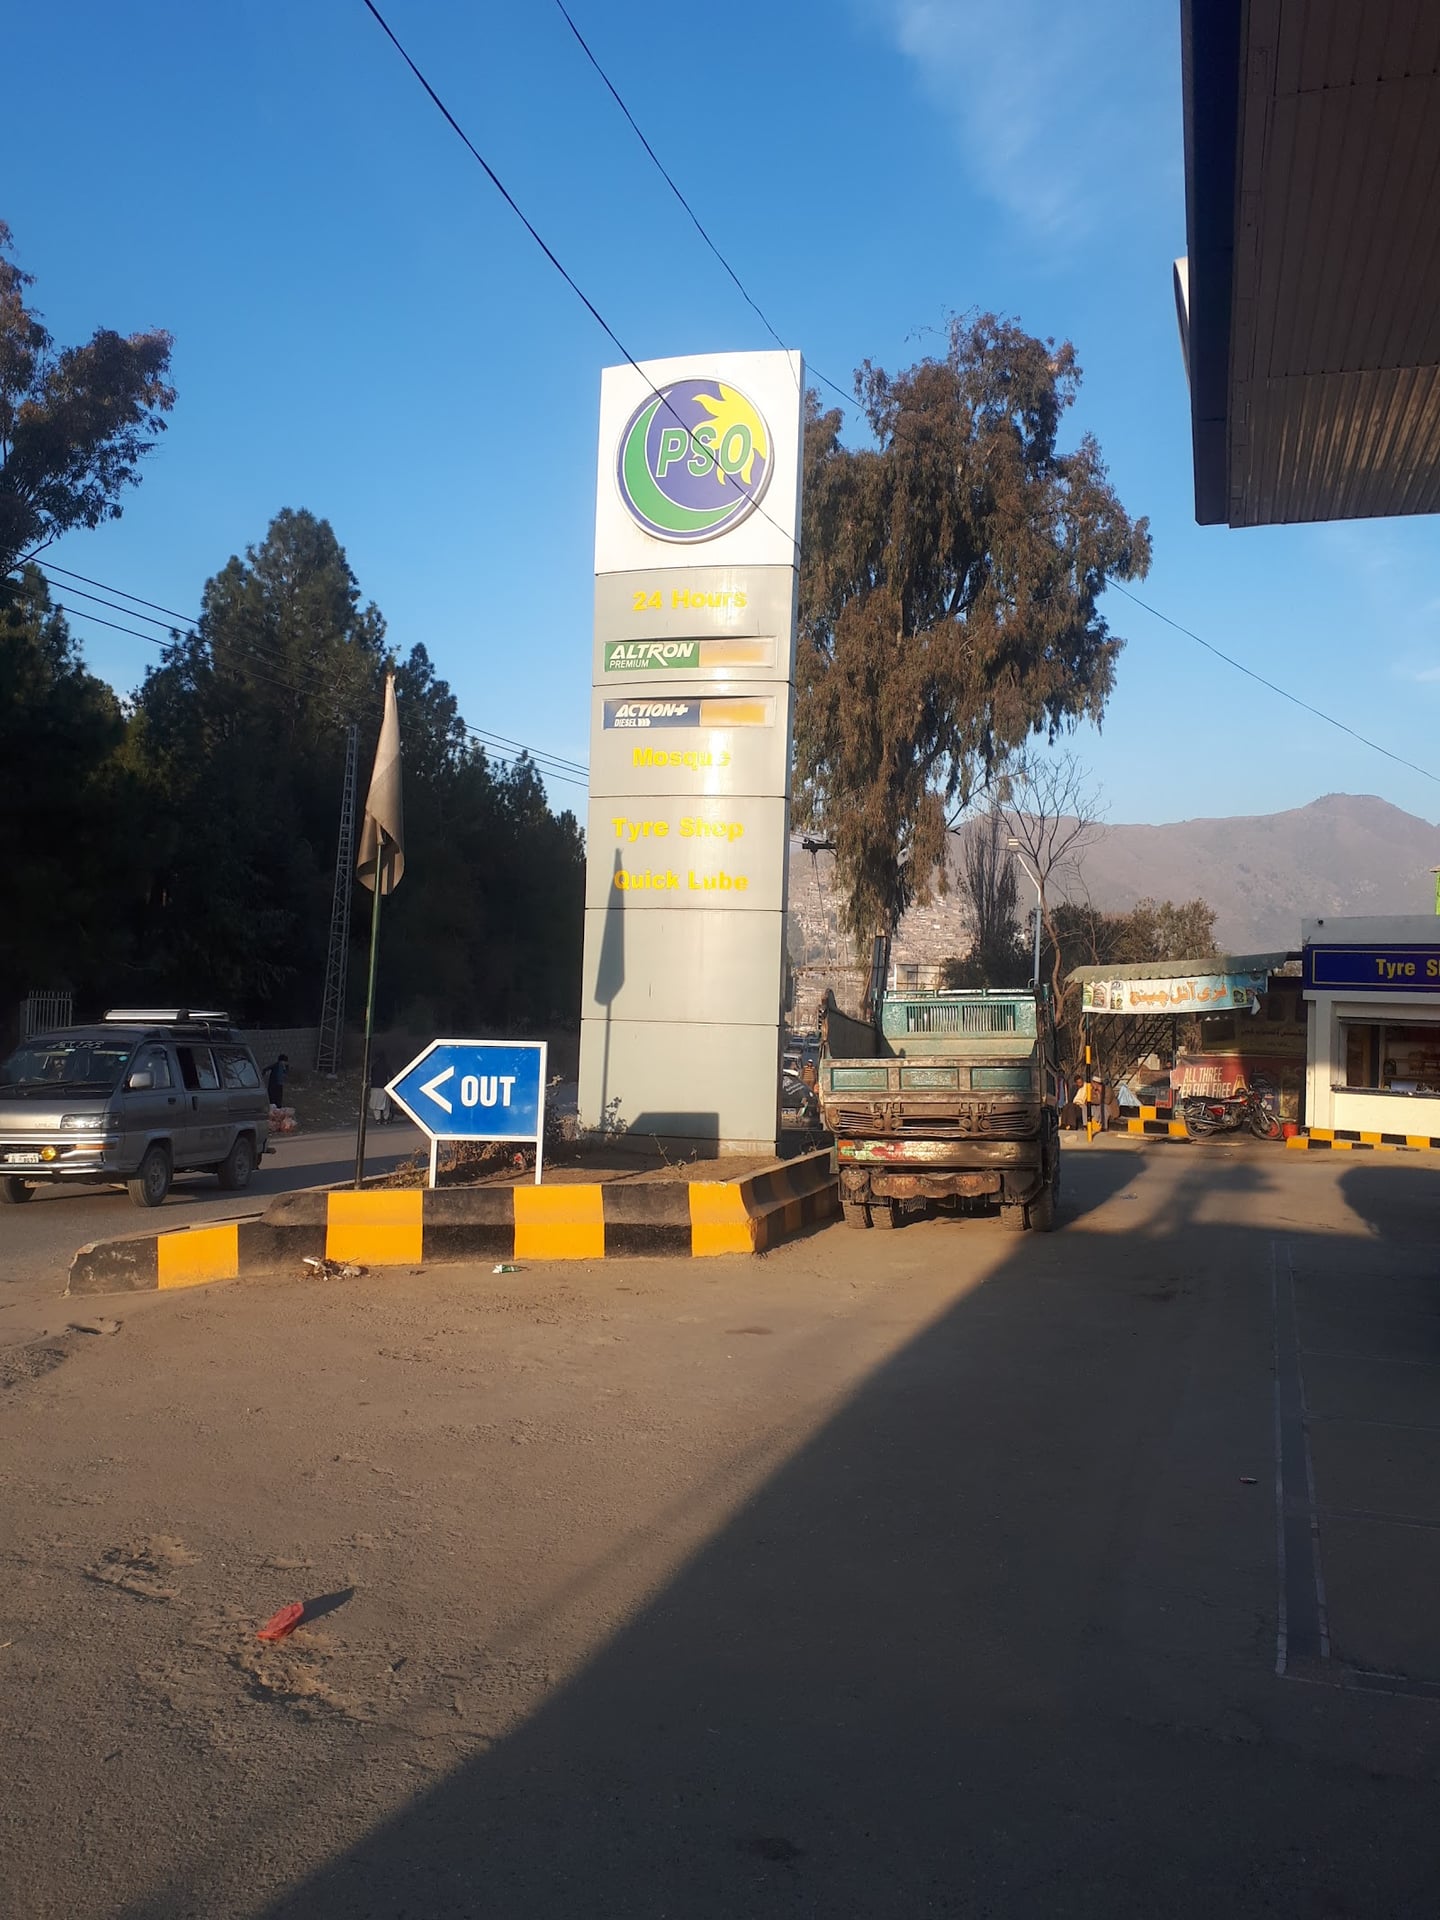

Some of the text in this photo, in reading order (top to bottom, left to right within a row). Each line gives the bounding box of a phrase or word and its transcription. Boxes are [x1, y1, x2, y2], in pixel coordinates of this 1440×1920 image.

[656, 423, 752, 478] PSO
[632, 588, 748, 611] 24 Hours
[609, 642, 695, 666] ALTRON
[609, 659, 649, 669] PREMIUM
[615, 703, 689, 718] ACTION+
[614, 718, 637, 727] DIESEL
[632, 747, 732, 771] Mosque
[611, 816, 745, 843] Tyre Shop
[614, 869, 750, 891] Quick Lube
[1375, 958, 1440, 979] Tyre S
[1183, 1066, 1223, 1083] ALL THREE
[460, 1075, 516, 1107] OUT
[1212, 1082, 1232, 1098] FREE
